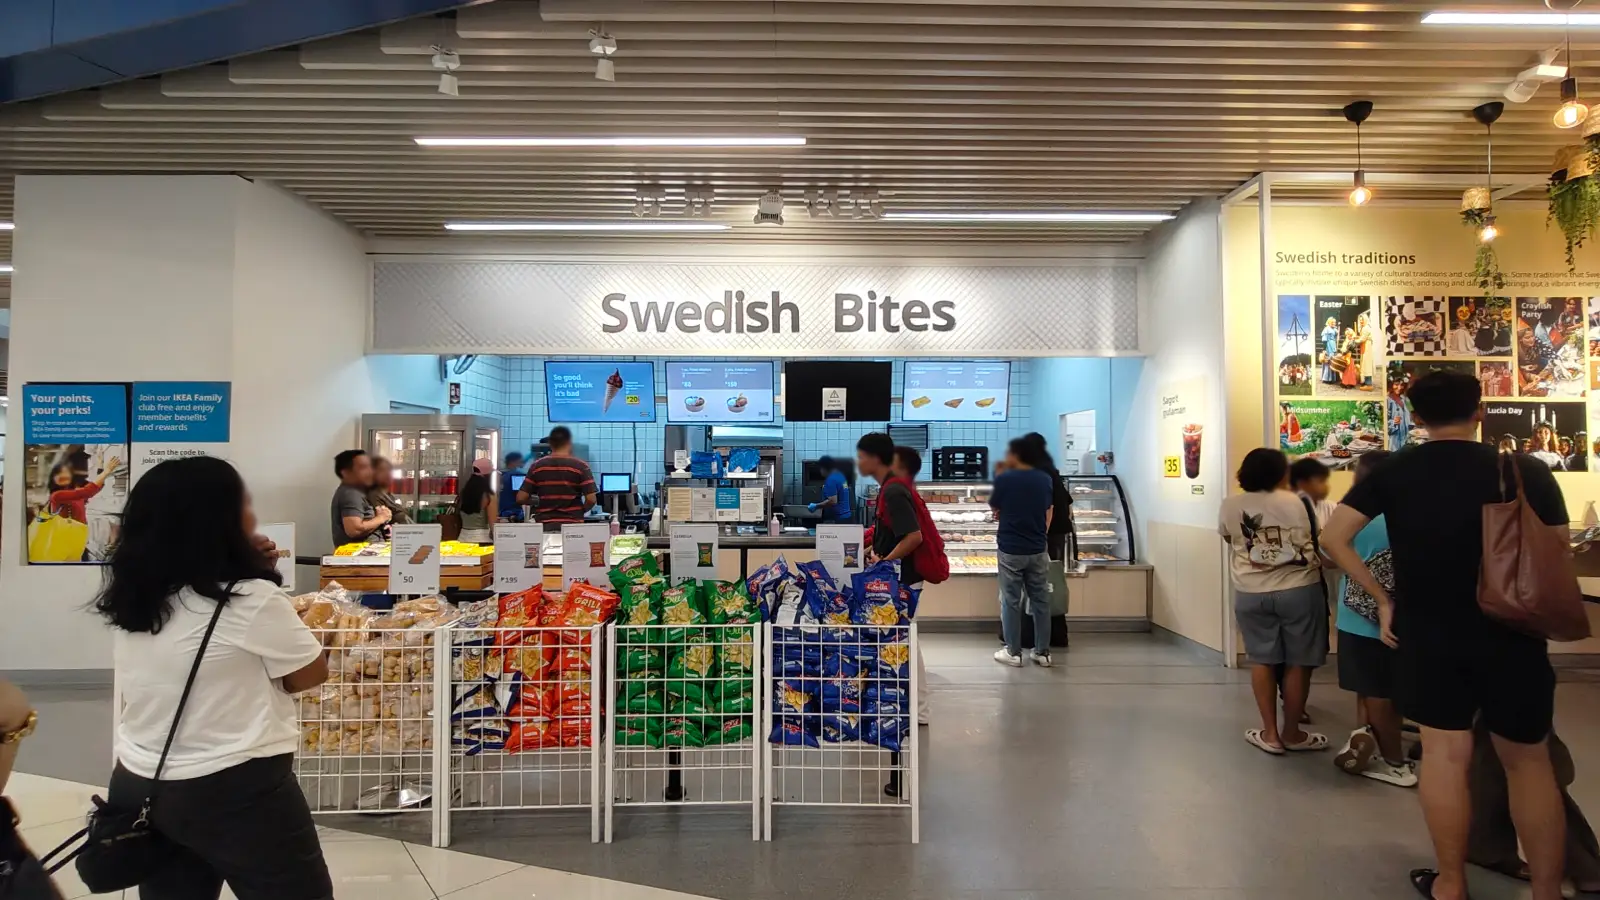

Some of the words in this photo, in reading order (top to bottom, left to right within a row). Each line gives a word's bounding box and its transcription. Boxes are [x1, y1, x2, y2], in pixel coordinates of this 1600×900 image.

[1276, 252, 1337, 264] Swedish
[1342, 252, 1416, 264] traditions
[1350, 270, 1374, 278] variety
[1390, 280, 1414, 288] dishes,
[1521, 302, 1552, 310] Crayfish
[600, 290, 800, 334] Swedish
[834, 290, 956, 332] Bites
[1522, 311, 1542, 319] Party
[30, 394, 56, 402] Your
[58, 394, 94, 405] points,
[194, 394, 222, 403] Family
[30, 407, 56, 416] your
[58, 406, 91, 416] perks!
[193, 404, 214, 412] enjoy
